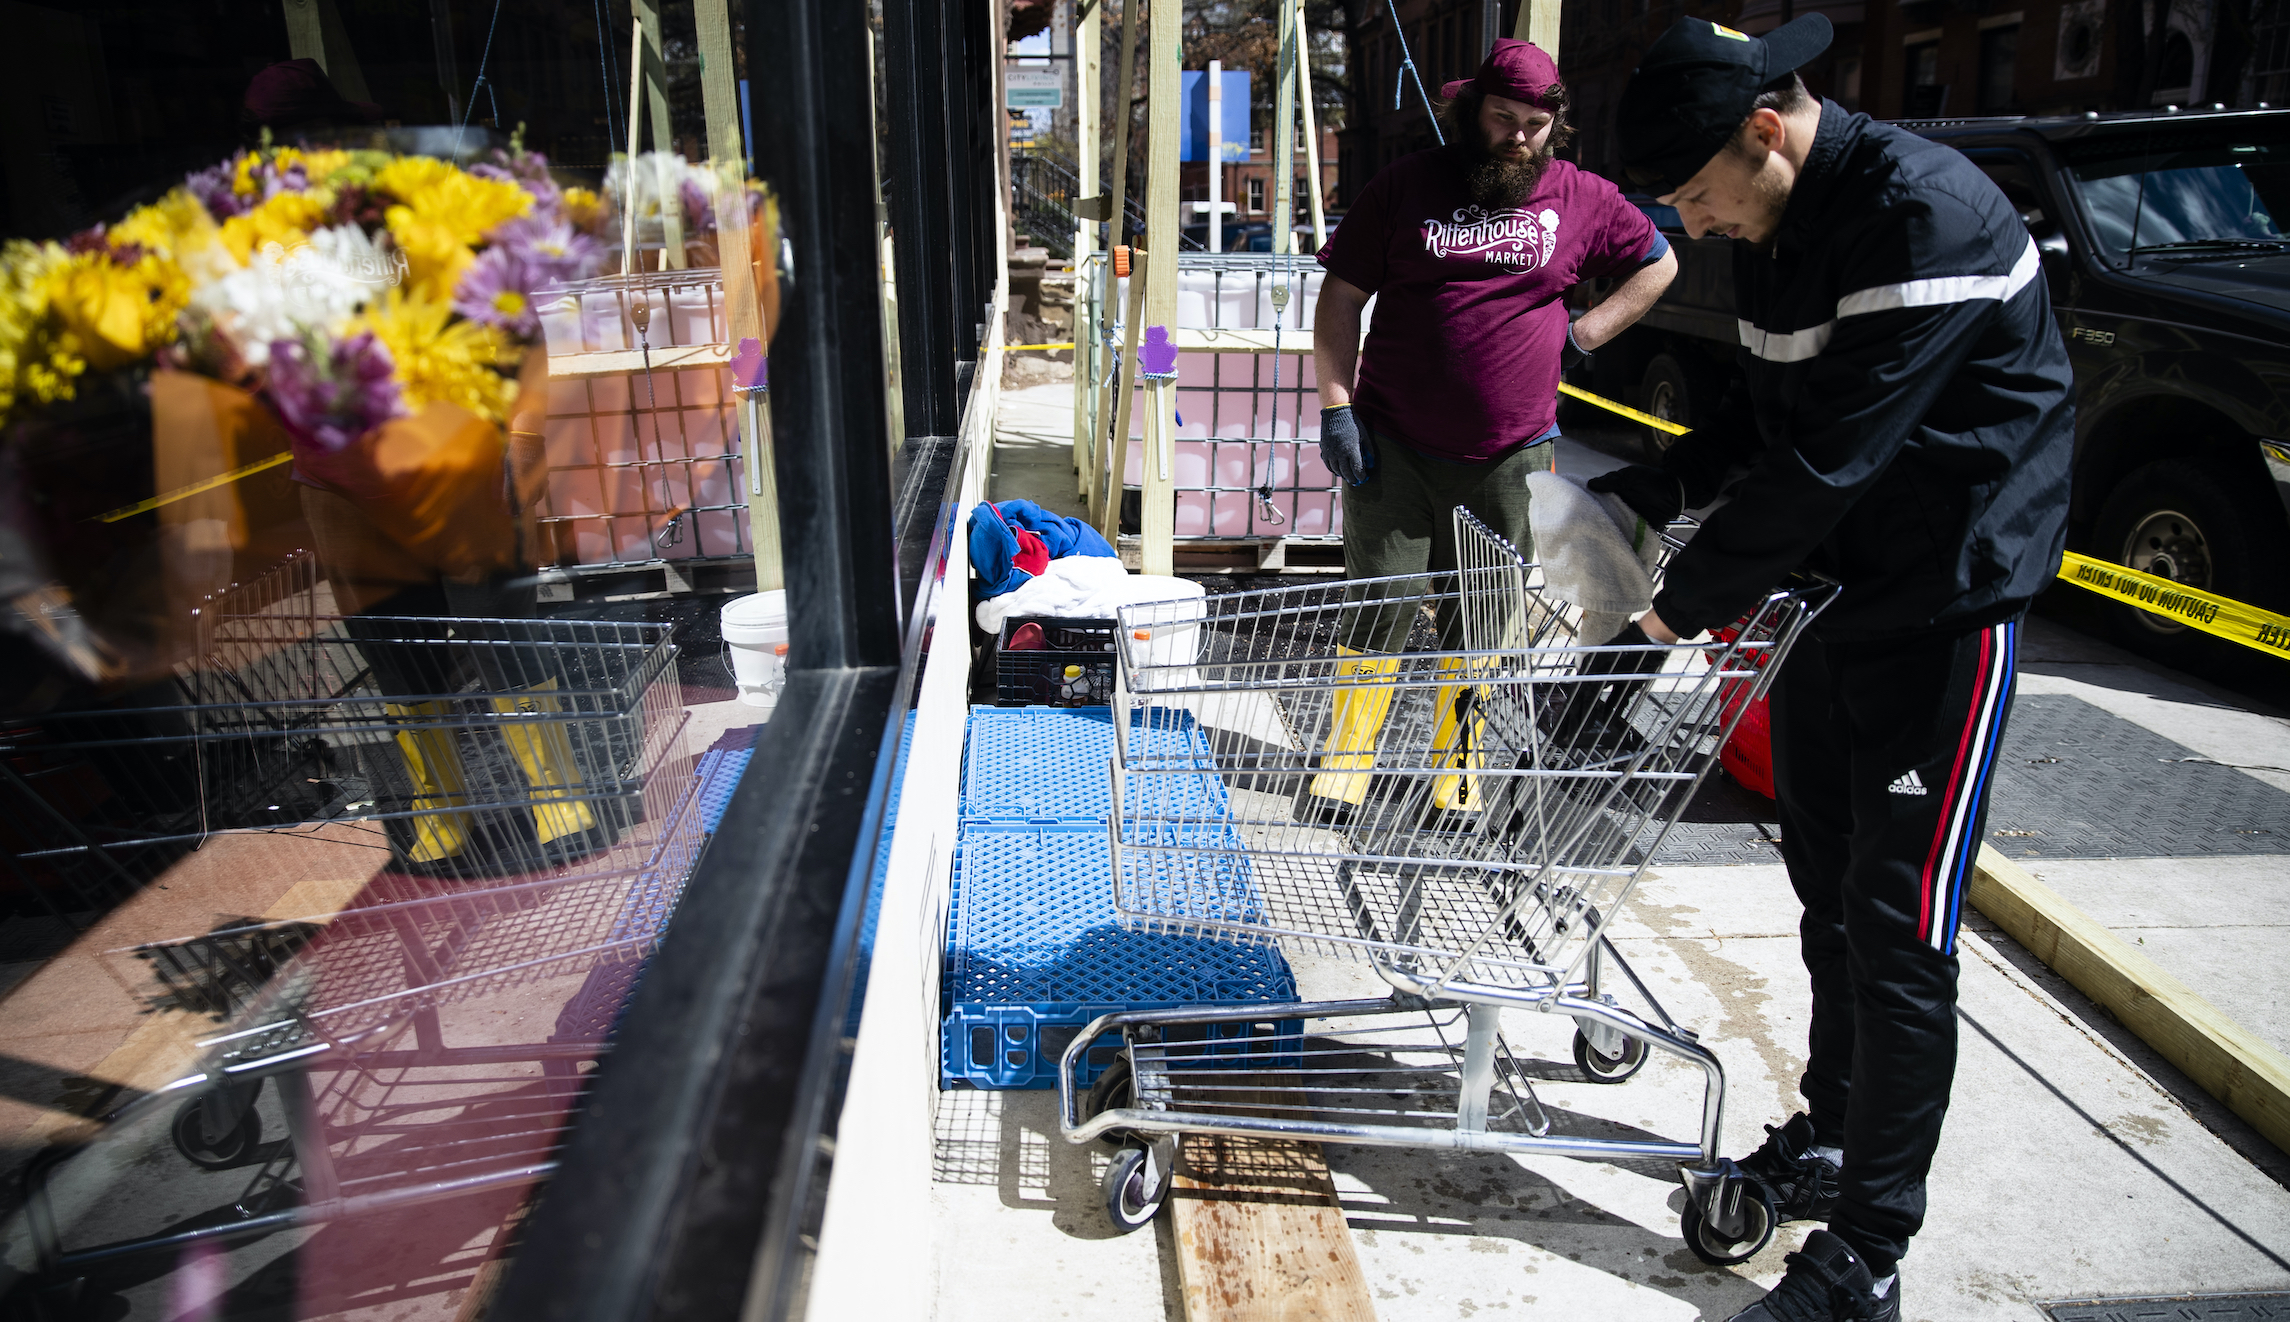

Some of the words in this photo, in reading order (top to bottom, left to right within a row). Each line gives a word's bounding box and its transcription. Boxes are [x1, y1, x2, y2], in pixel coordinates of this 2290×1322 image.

[1423, 214, 1539, 258] Rittenhouse
[1485, 251, 1533, 266] MARKET
[2072, 327, 2115, 344] F350
[1888, 784, 1927, 796] adidas
